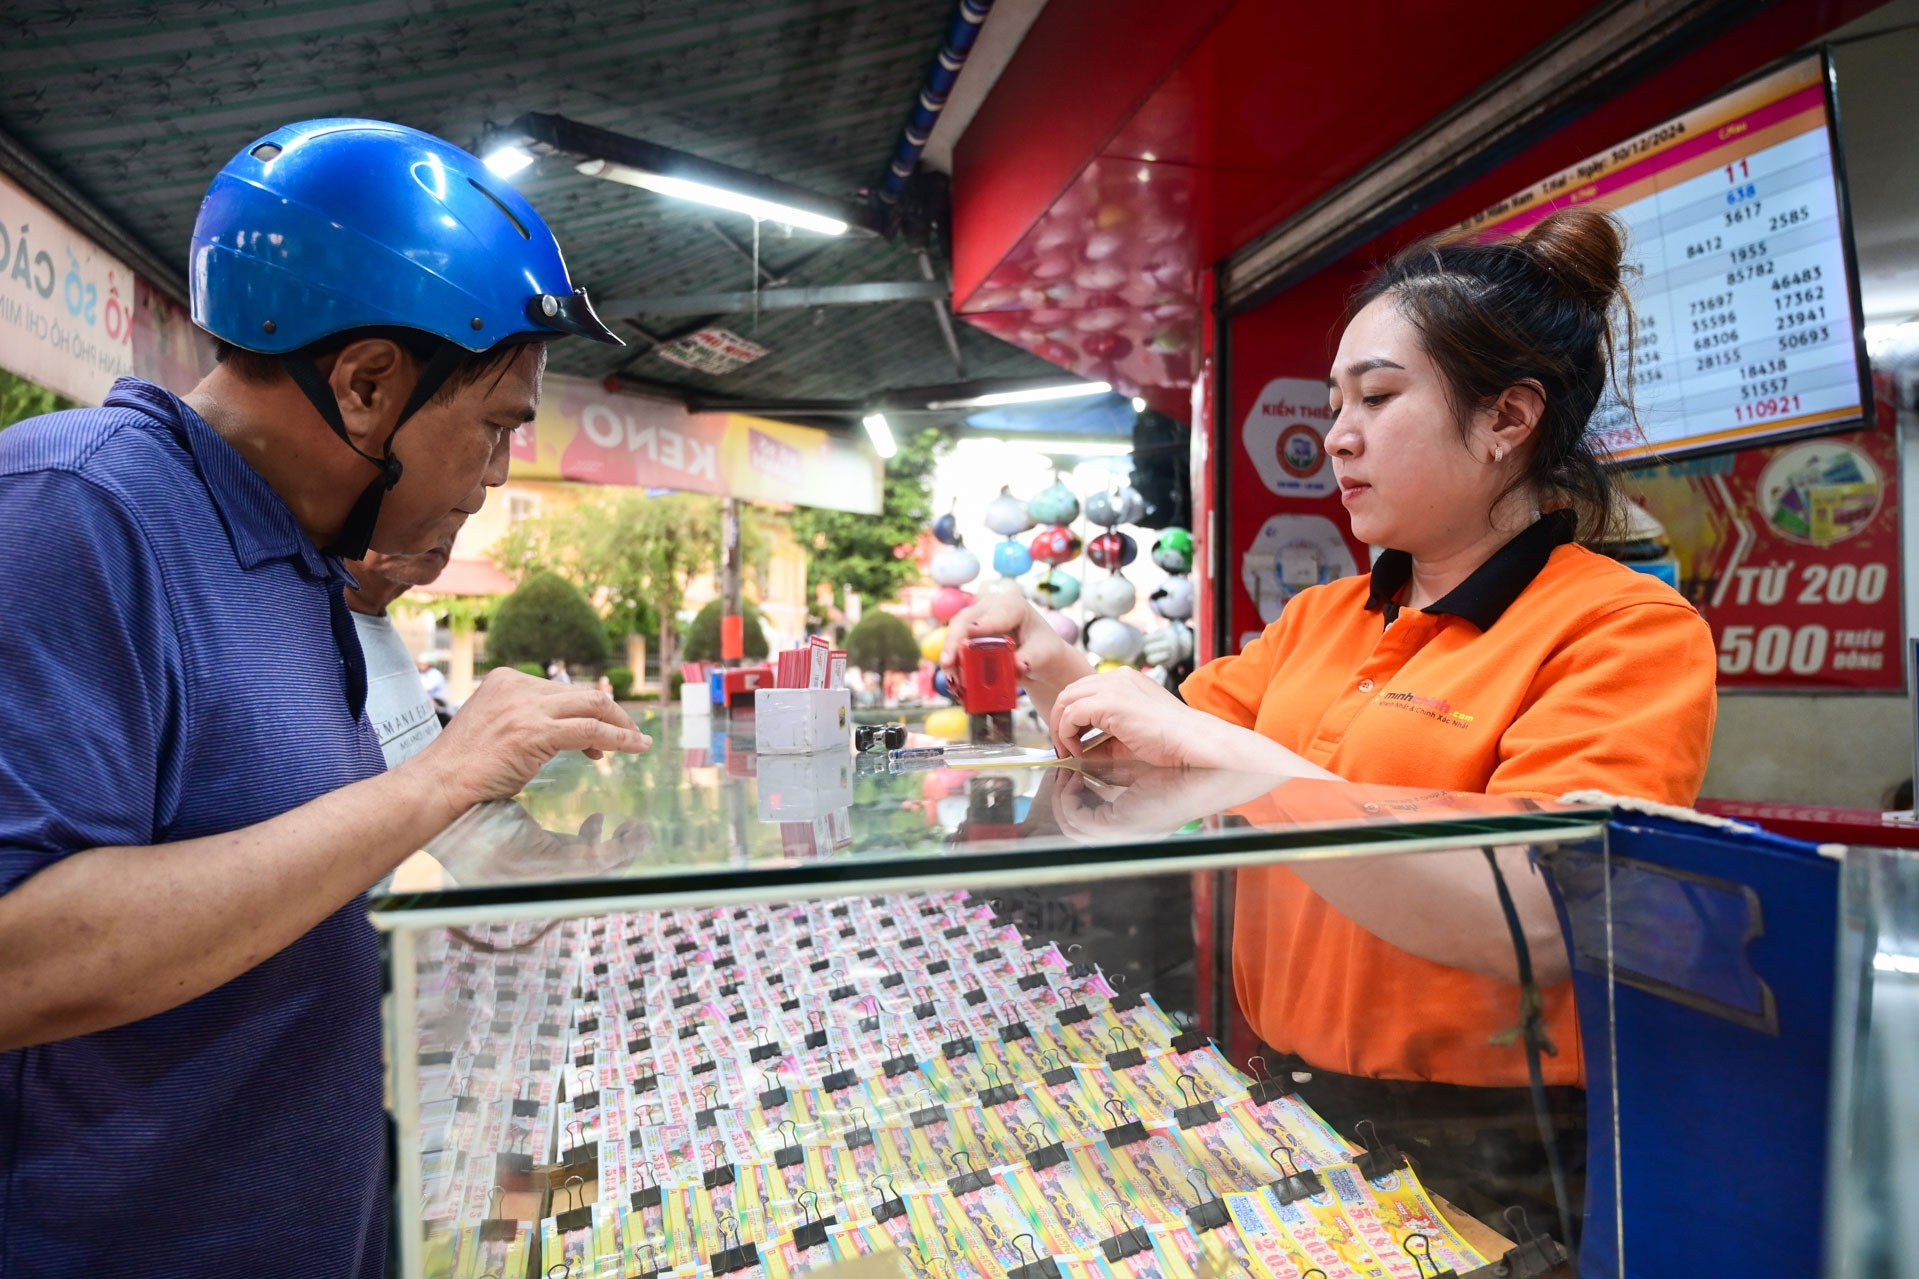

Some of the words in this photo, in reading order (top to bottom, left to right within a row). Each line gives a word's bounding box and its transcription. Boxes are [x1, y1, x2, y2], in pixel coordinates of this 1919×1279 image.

[1611, 122, 1686, 161] 30/12/2024
[1725, 158, 1749, 184] 11
[1726, 183, 1756, 205] 638
[1725, 203, 1762, 227] 3617
[1769, 206, 1810, 231] 2585
[1687, 237, 1722, 259] 8412
[1730, 241, 1767, 264] 1955
[1727, 262, 1775, 287] 85782
[1771, 266, 1822, 292] 46483
[1690, 292, 1734, 316] 73697
[1774, 286, 1825, 311] 17362
[1692, 311, 1737, 335] 35596
[1775, 307, 1826, 331] 23941
[1694, 329, 1739, 352] 68306
[1778, 327, 1830, 352] 50693
[1697, 350, 1742, 372] 28155
[1740, 359, 1787, 381] 18438
[1741, 378, 1788, 400] 51557
[1735, 395, 1800, 422] 110921
[1736, 559, 1795, 605] TỪ
[1798, 563, 1888, 605] 200
[1718, 623, 1829, 675] 500
